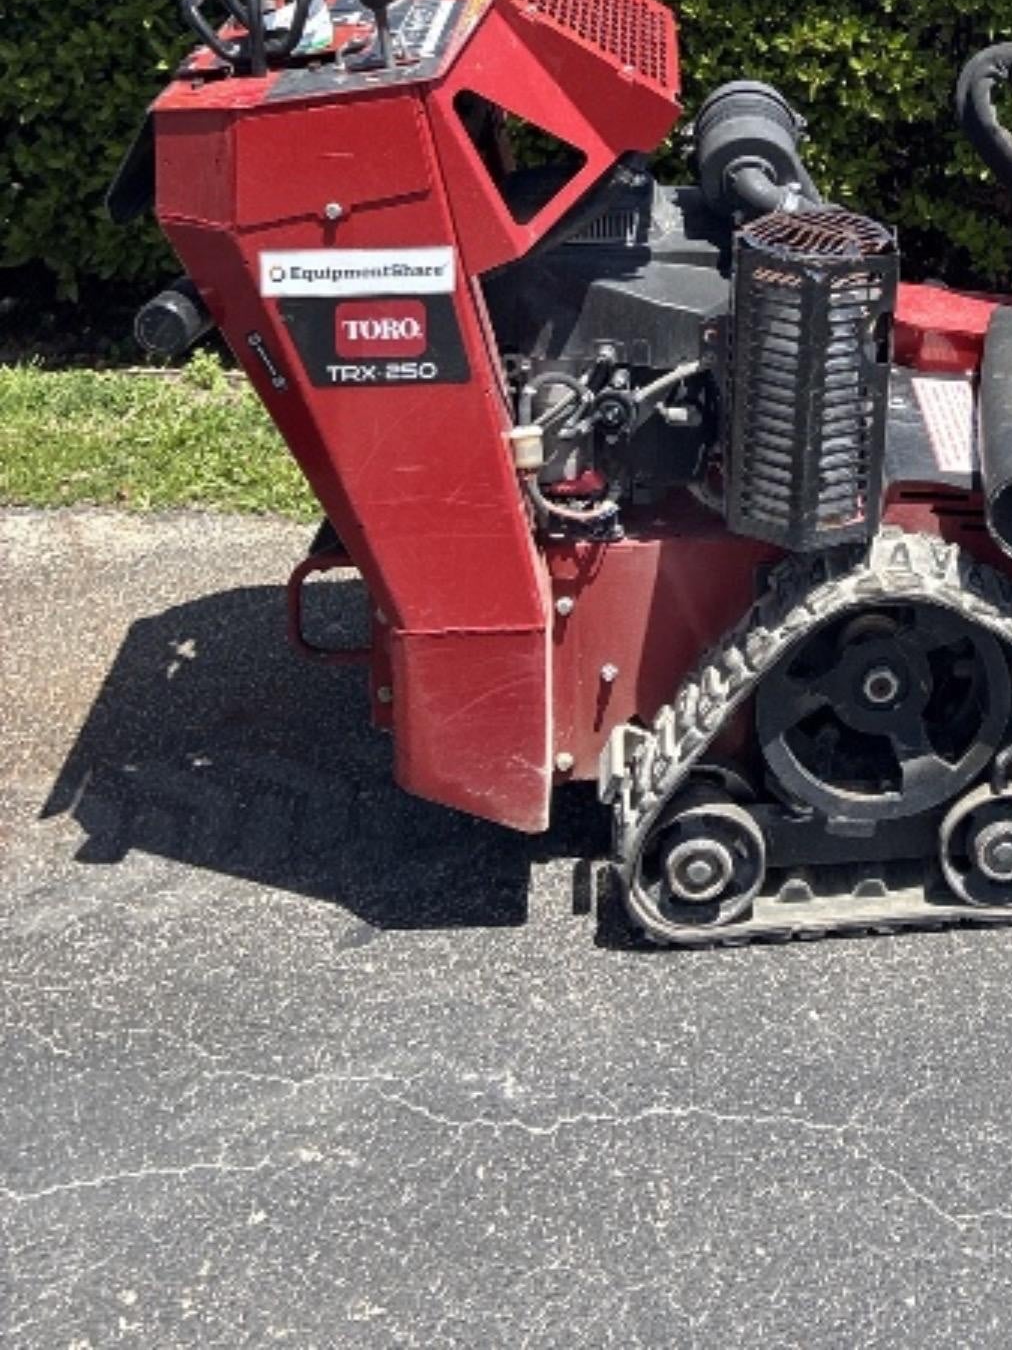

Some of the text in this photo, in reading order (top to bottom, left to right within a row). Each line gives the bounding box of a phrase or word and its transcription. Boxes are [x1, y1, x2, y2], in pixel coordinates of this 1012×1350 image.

[289, 263, 444, 283] EquipmentShare
[341, 317, 420, 340] TORO
[326, 361, 438, 382] TRX-250
